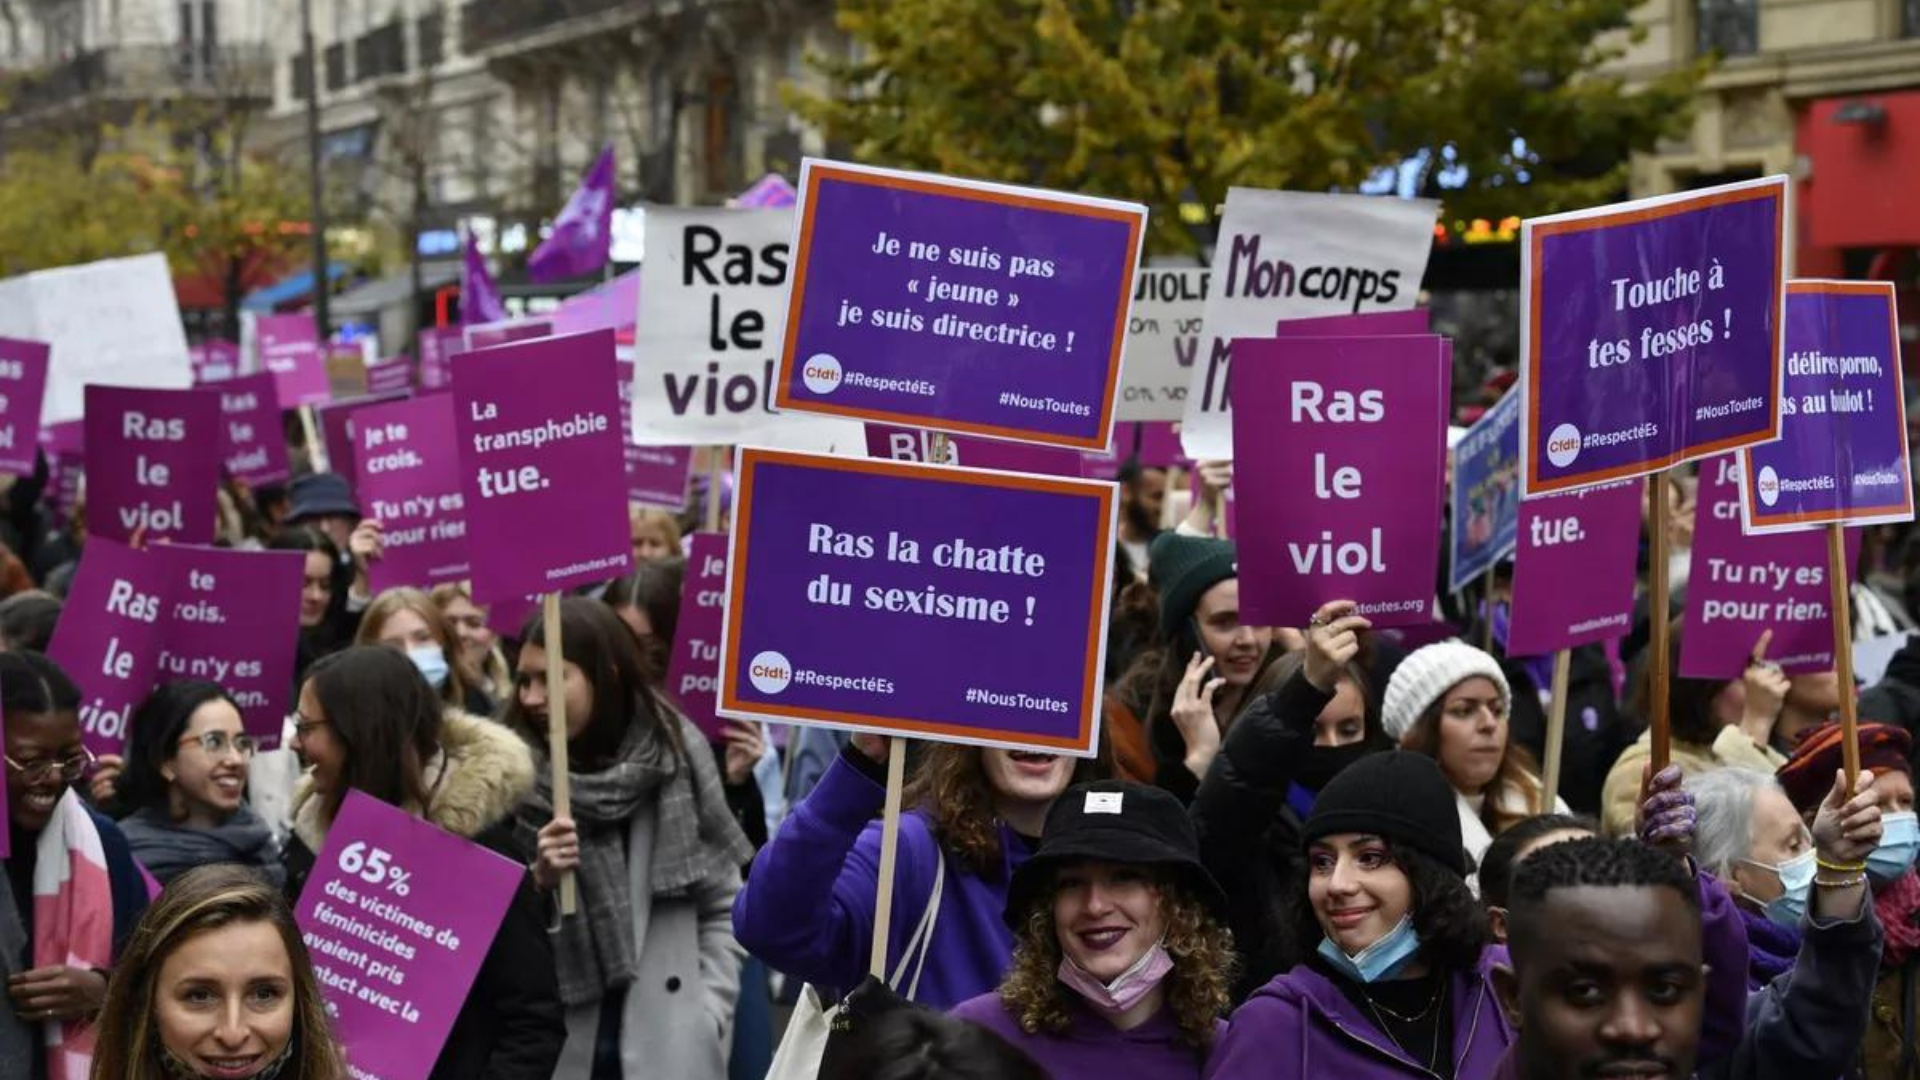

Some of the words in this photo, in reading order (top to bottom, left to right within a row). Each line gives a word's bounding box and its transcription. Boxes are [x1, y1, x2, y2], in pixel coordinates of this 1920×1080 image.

[683, 225, 789, 286] Ras
[872, 231, 900, 256] Je
[909, 241, 940, 261] ne
[948, 246, 1001, 270] suis
[1009, 255, 1055, 278] pas
[1225, 234, 1295, 298] Mon
[1300, 266, 1400, 313] corps
[1612, 267, 1700, 311] Touche
[1708, 257, 1724, 289] à
[926, 276, 999, 305] jeune
[710, 293, 764, 351] le
[837, 299, 862, 327] je
[871, 308, 924, 332] suis
[932, 314, 1056, 350] directrice
[1065, 331, 1075, 352] !
[1588, 336, 1631, 369] tes
[1639, 318, 1714, 360] fesses
[1723, 308, 1732, 338] !
[0, 360, 23, 381] as
[1840, 356, 1882, 379] porno,
[663, 359, 780, 416] viol
[844, 372, 936, 396] #RespectéEs
[472, 401, 497, 421] La
[999, 391, 1090, 417] #NousToutes
[1291, 381, 1385, 423] Ras
[1696, 397, 1763, 421] #NousToutes
[1802, 395, 1826, 414] au
[1867, 388, 1873, 411] !
[123, 411, 185, 440] Ras
[364, 428, 384, 449] Je
[386, 424, 407, 441] te
[473, 411, 608, 453] transphobie
[1583, 422, 1658, 448] #RespectéEs
[137, 456, 169, 485] le
[366, 449, 423, 474] crois.
[1314, 453, 1362, 499] le
[477, 464, 550, 498] tue.
[1780, 476, 1834, 492] #RespectéEs
[120, 501, 183, 529] viol
[372, 500, 400, 520] Tu
[403, 495, 434, 519] n'y
[439, 493, 464, 511] es
[1531, 515, 1586, 547] tue.
[808, 523, 874, 558] Ras
[887, 531, 920, 564] la
[932, 538, 1045, 577] chatte
[1288, 527, 1386, 575] viol
[190, 568, 215, 591] te
[546, 553, 627, 580] noustoutes.org
[701, 555, 724, 577] Je
[1708, 558, 1742, 582] Tu
[1749, 562, 1789, 591] n'y
[1795, 566, 1823, 585] es
[107, 578, 159, 622] Ras
[807, 574, 851, 606] du
[865, 585, 1010, 623] sexisme
[1024, 596, 1036, 626] !
[1352, 599, 1424, 615] stoutes.org
[1703, 599, 1769, 624] pour
[1775, 598, 1827, 622] rien.
[103, 638, 133, 679] le
[689, 640, 717, 660] Tu
[192, 656, 229, 681] n'y
[234, 659, 262, 677] es
[794, 669, 894, 694] #RespectéEs
[966, 688, 1068, 713] #NousToutes
[338, 841, 411, 896] 65%
[324, 879, 357, 904] des
[360, 895, 435, 939] victimes
[436, 928, 460, 951] de
[313, 901, 416, 960] féminicides
[303, 931, 368, 969] avaient
[366, 957, 405, 985] pris
[358, 984, 400, 1015] avec
[401, 1001, 420, 1023] la
